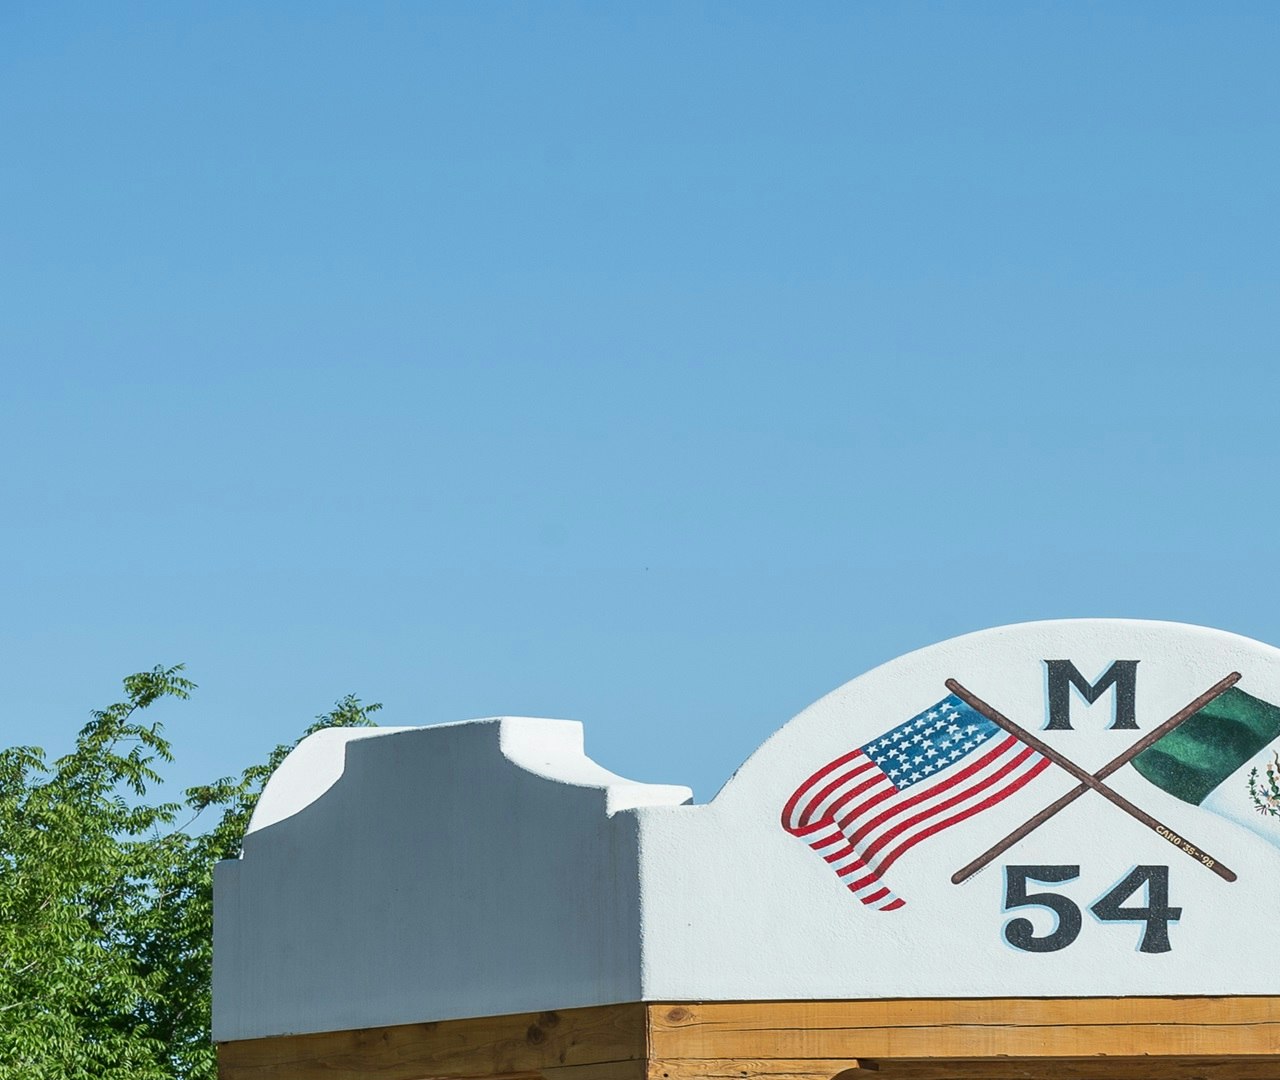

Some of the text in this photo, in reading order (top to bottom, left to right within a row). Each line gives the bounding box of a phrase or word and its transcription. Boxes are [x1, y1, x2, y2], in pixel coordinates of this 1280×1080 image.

[1041, 659, 1141, 730] M
[1155, 825, 1182, 845] CANO
[1001, 865, 1182, 953] 54
